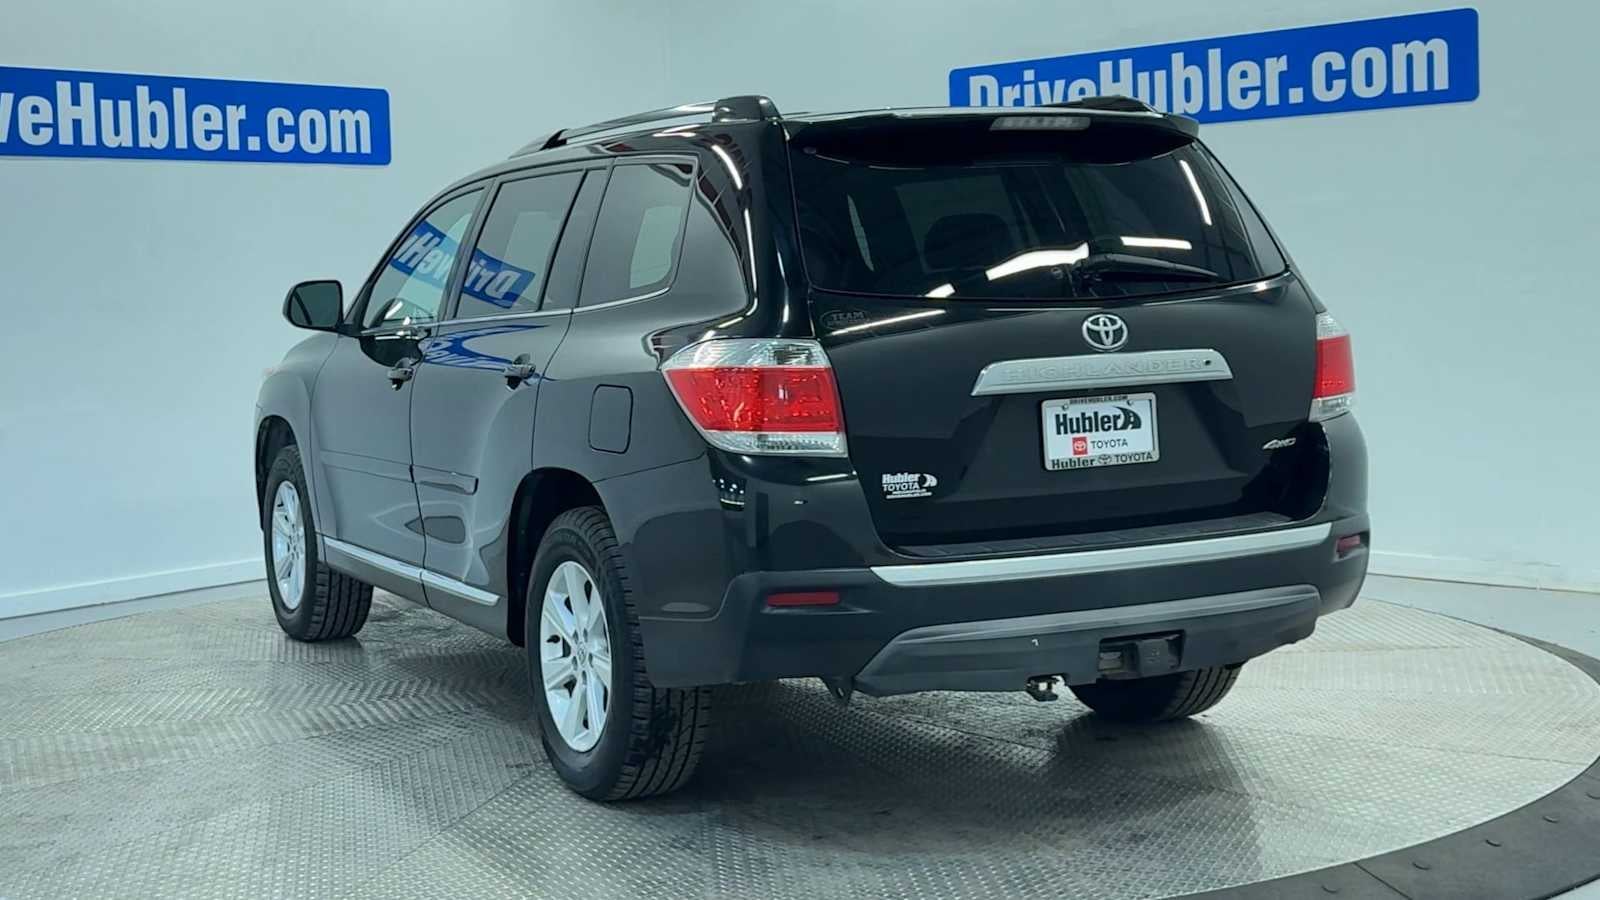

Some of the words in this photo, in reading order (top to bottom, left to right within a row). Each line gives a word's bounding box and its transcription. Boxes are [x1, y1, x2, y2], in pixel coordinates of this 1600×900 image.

[1008, 358, 1201, 382] HIGHLANDER
[1055, 411, 1121, 435] Hubler
[1090, 439, 1128, 449] TOYOTA
[1051, 458, 1096, 470] Hubler
[1114, 452, 1153, 464] TOYOTA
[882, 472, 921, 484] Hubler
[882, 482, 920, 492] TOYOTA
